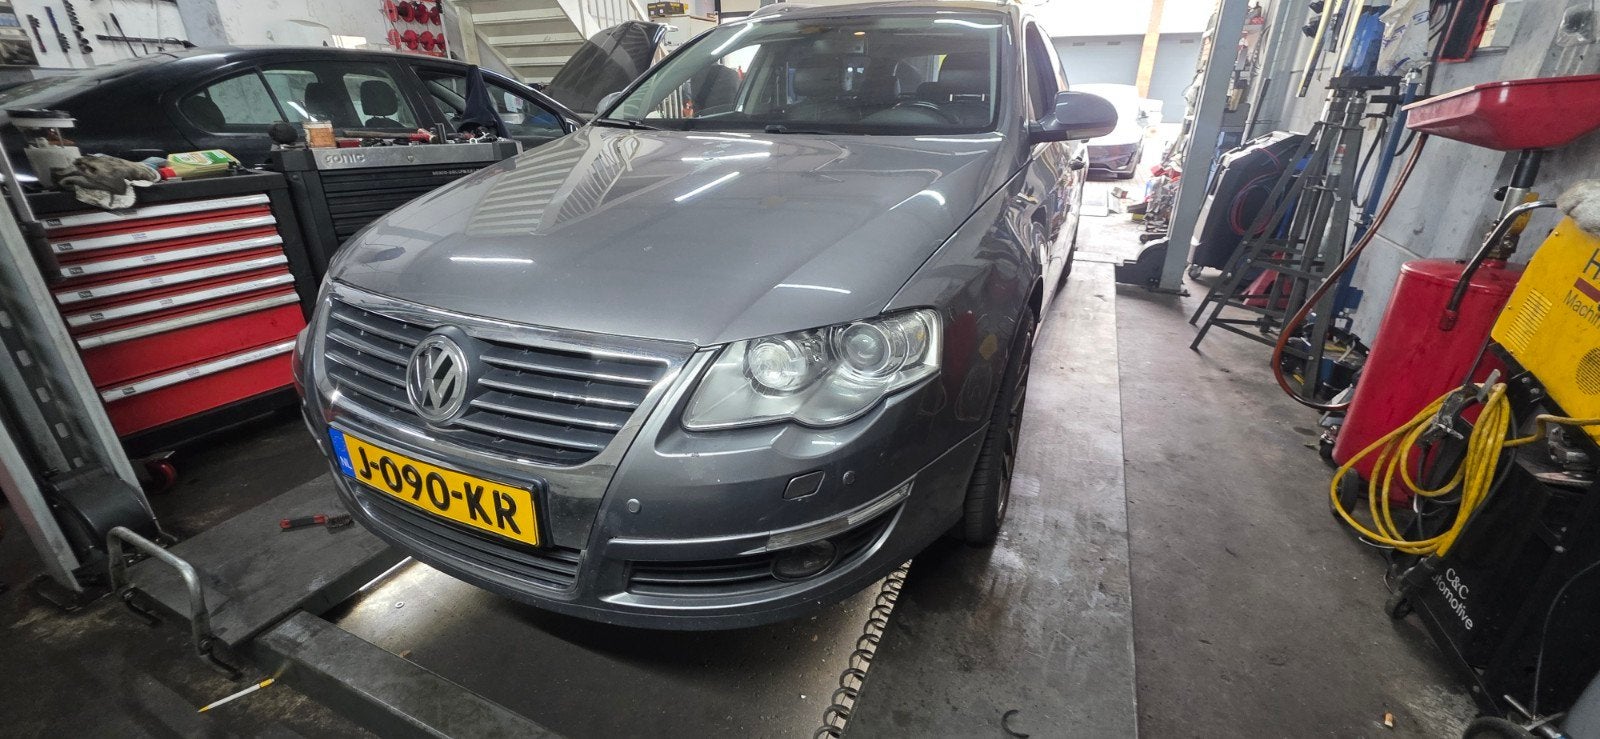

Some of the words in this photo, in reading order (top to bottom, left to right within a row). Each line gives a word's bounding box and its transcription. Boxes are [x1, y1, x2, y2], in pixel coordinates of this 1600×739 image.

[339, 456, 353, 470] NL
[357, 446, 522, 536] J-090-KR
[1431, 574, 1474, 630] utomotive
[1446, 567, 1470, 600] C&C
